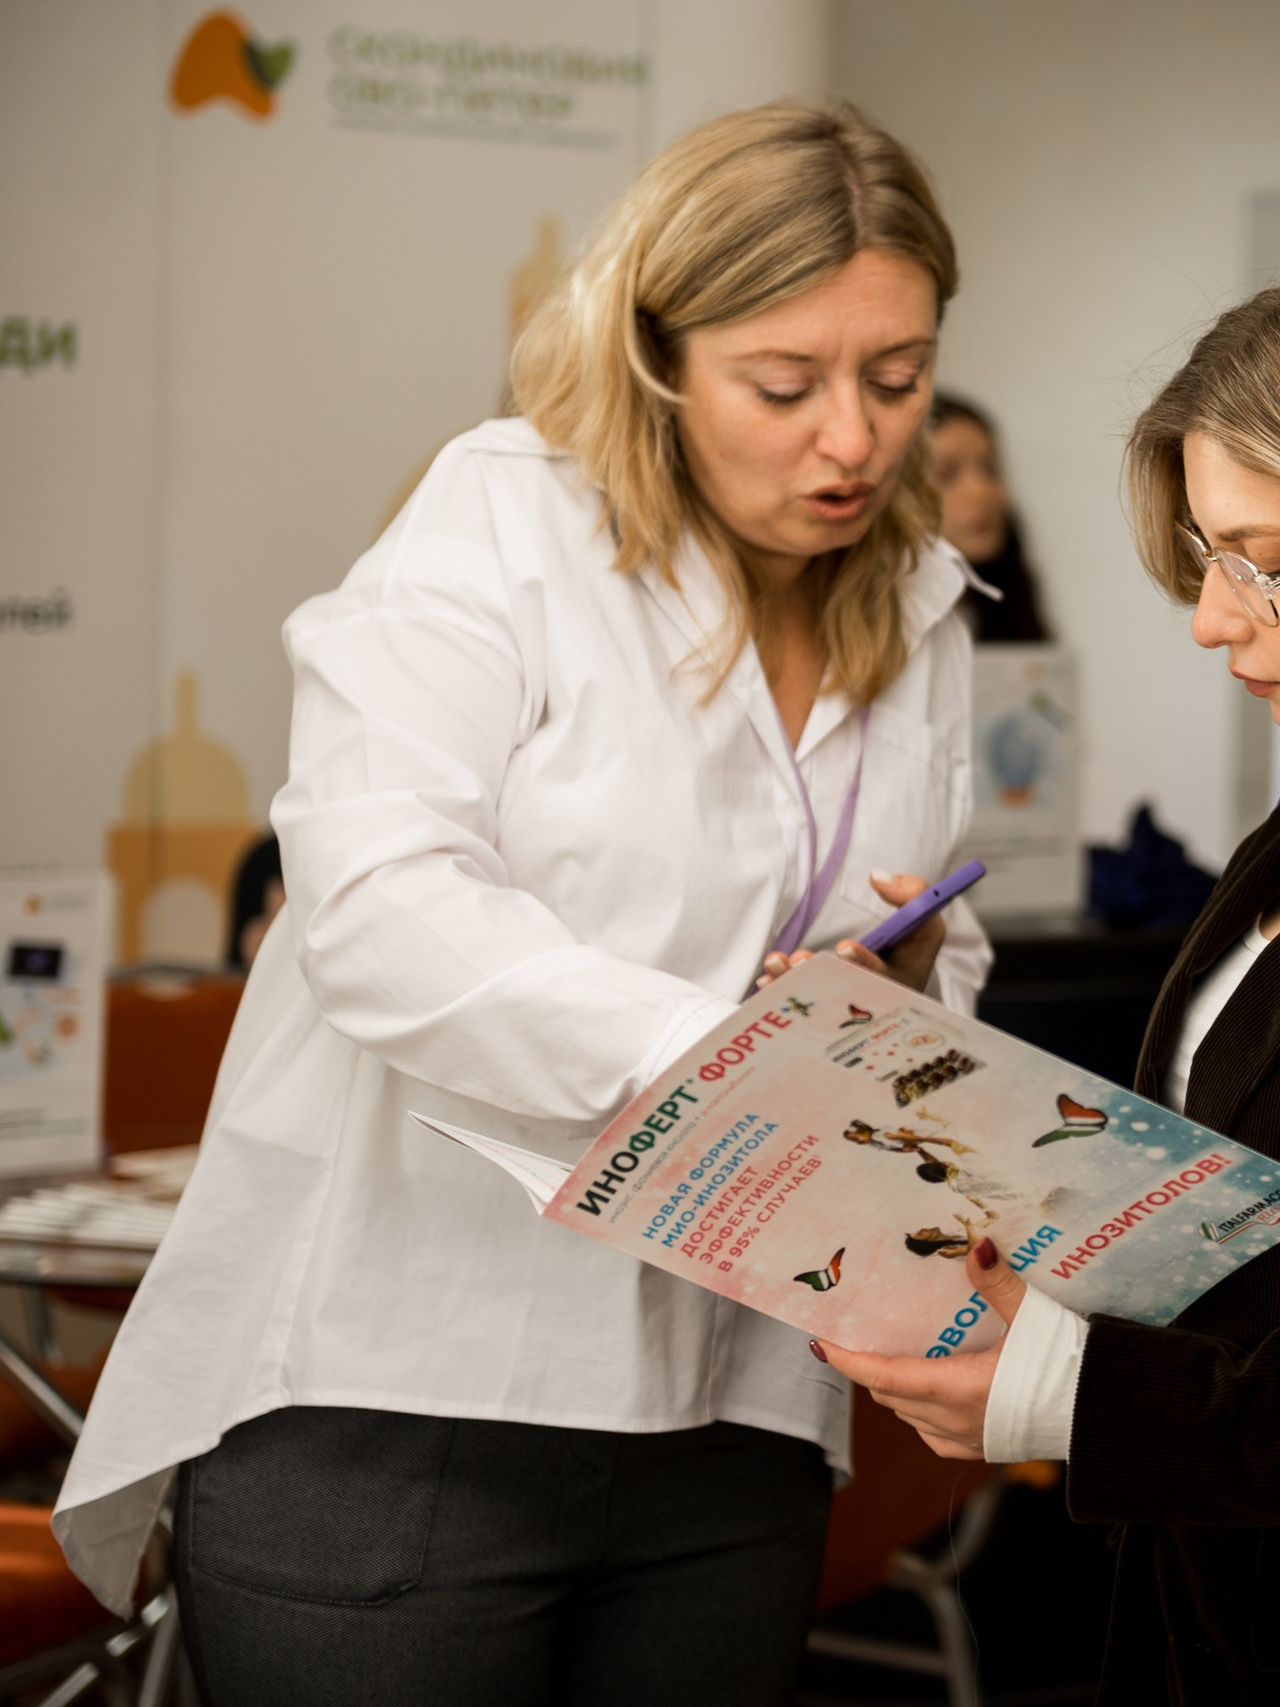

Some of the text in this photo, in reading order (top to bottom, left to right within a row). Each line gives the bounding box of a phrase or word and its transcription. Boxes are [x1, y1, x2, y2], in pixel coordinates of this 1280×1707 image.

[698, 1010, 793, 1083] ФОРТЕ
[642, 1113, 761, 1240] НОВАЯ ФОРМУЛА
[661, 1122, 779, 1248] МИО-ИНОЗИТОЛА
[680, 1166, 758, 1258] ДОСТИГАЕТ
[699, 1134, 820, 1264] ЭФФЕКТИВНОСТИ
[1050, 1152, 1233, 1281] ИНОЗИТОЛОВ!
[717, 1260, 733, 1273] В
[729, 1226, 761, 1258] 95%
[925, 1224, 1064, 1359] ЭВОЛЦИЯ
